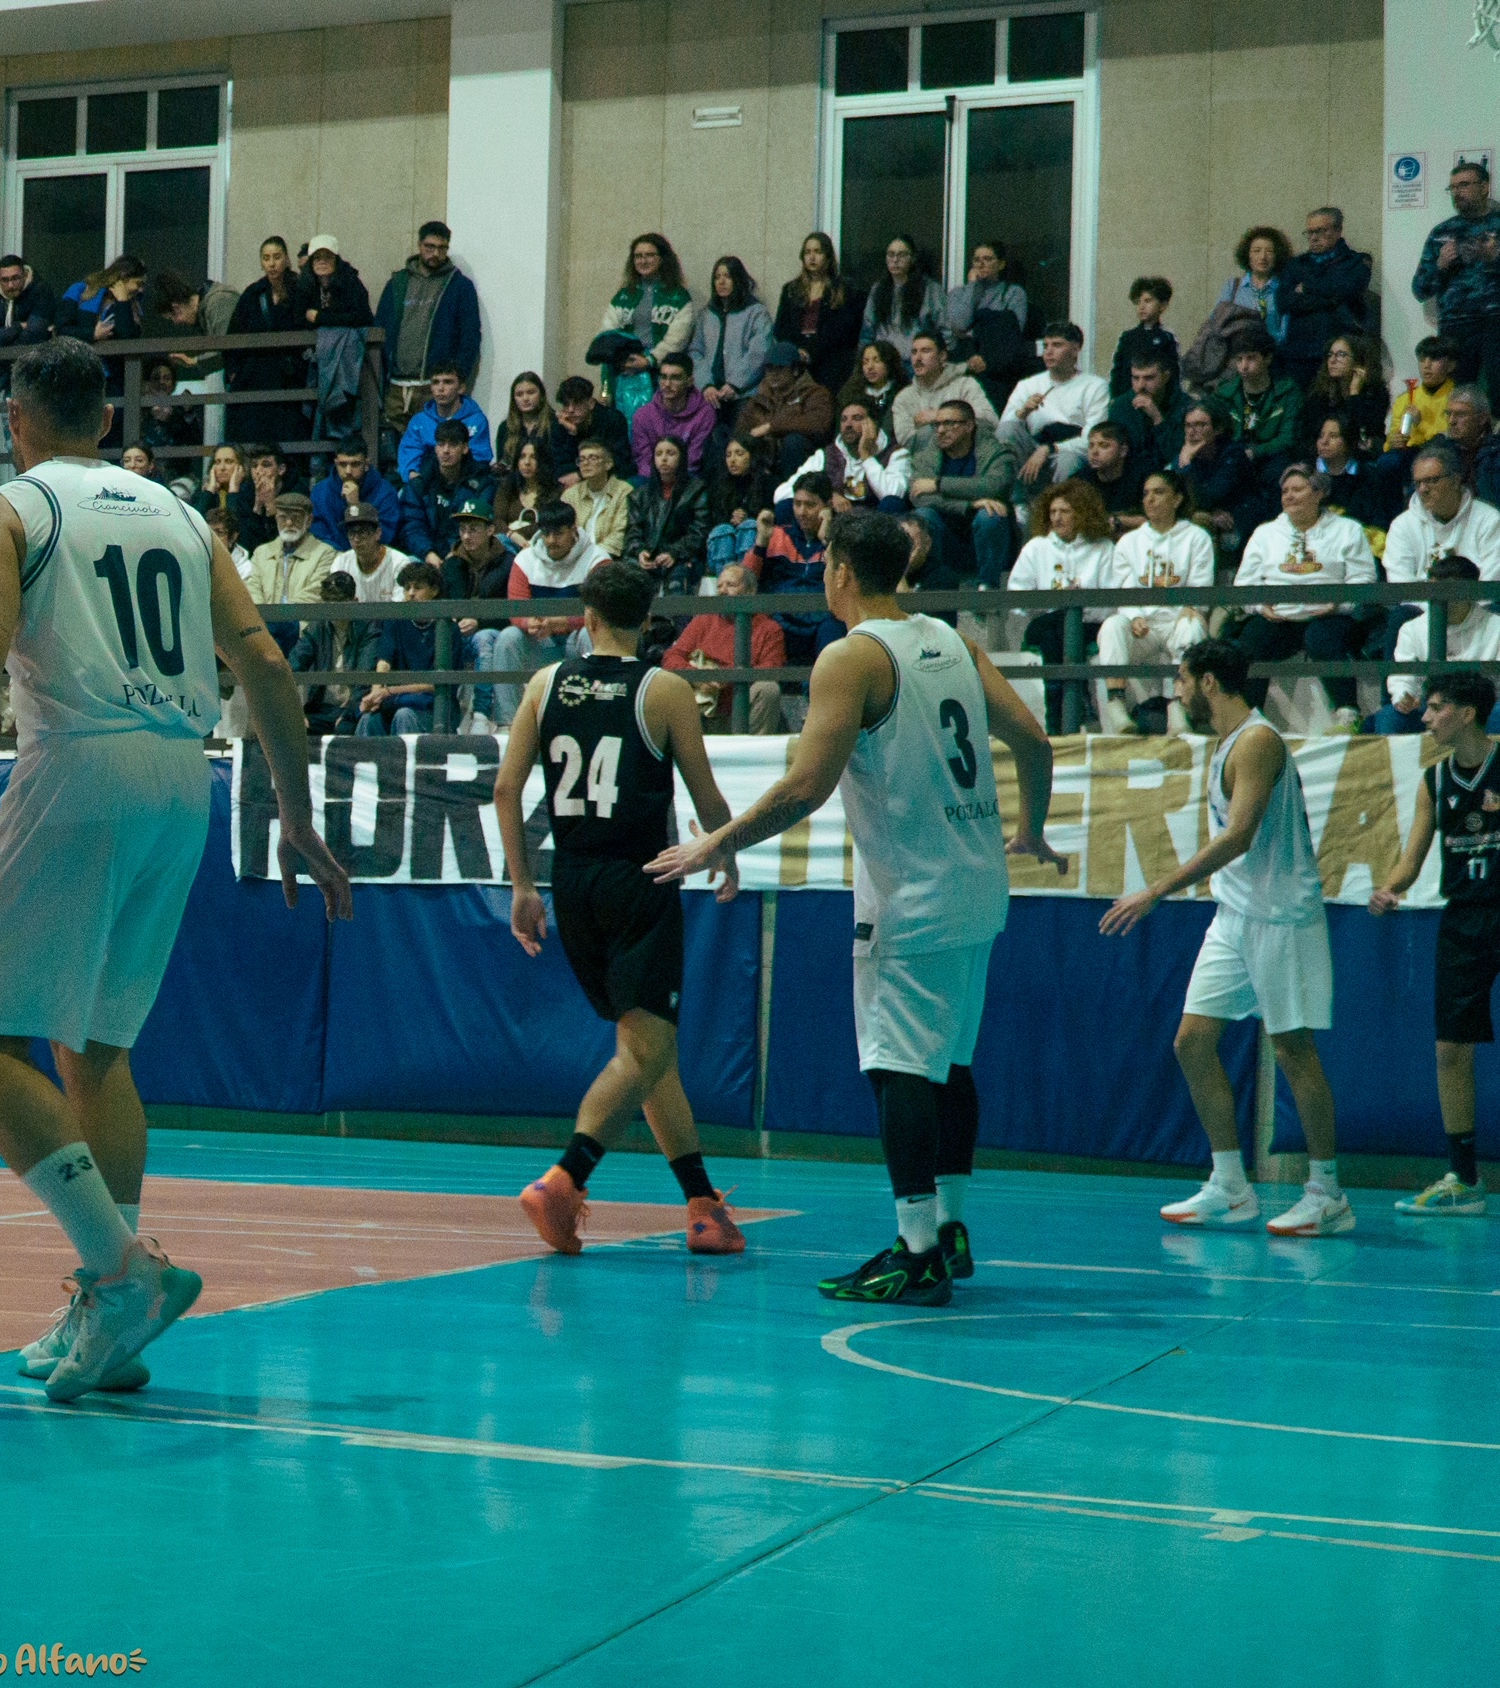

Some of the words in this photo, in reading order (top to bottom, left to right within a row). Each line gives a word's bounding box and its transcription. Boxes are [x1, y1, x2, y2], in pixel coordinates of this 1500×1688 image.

[93, 544, 185, 677] 10
[550, 734, 623, 819] 24
[939, 698, 977, 790] 3
[58, 1155, 94, 1183] 23
